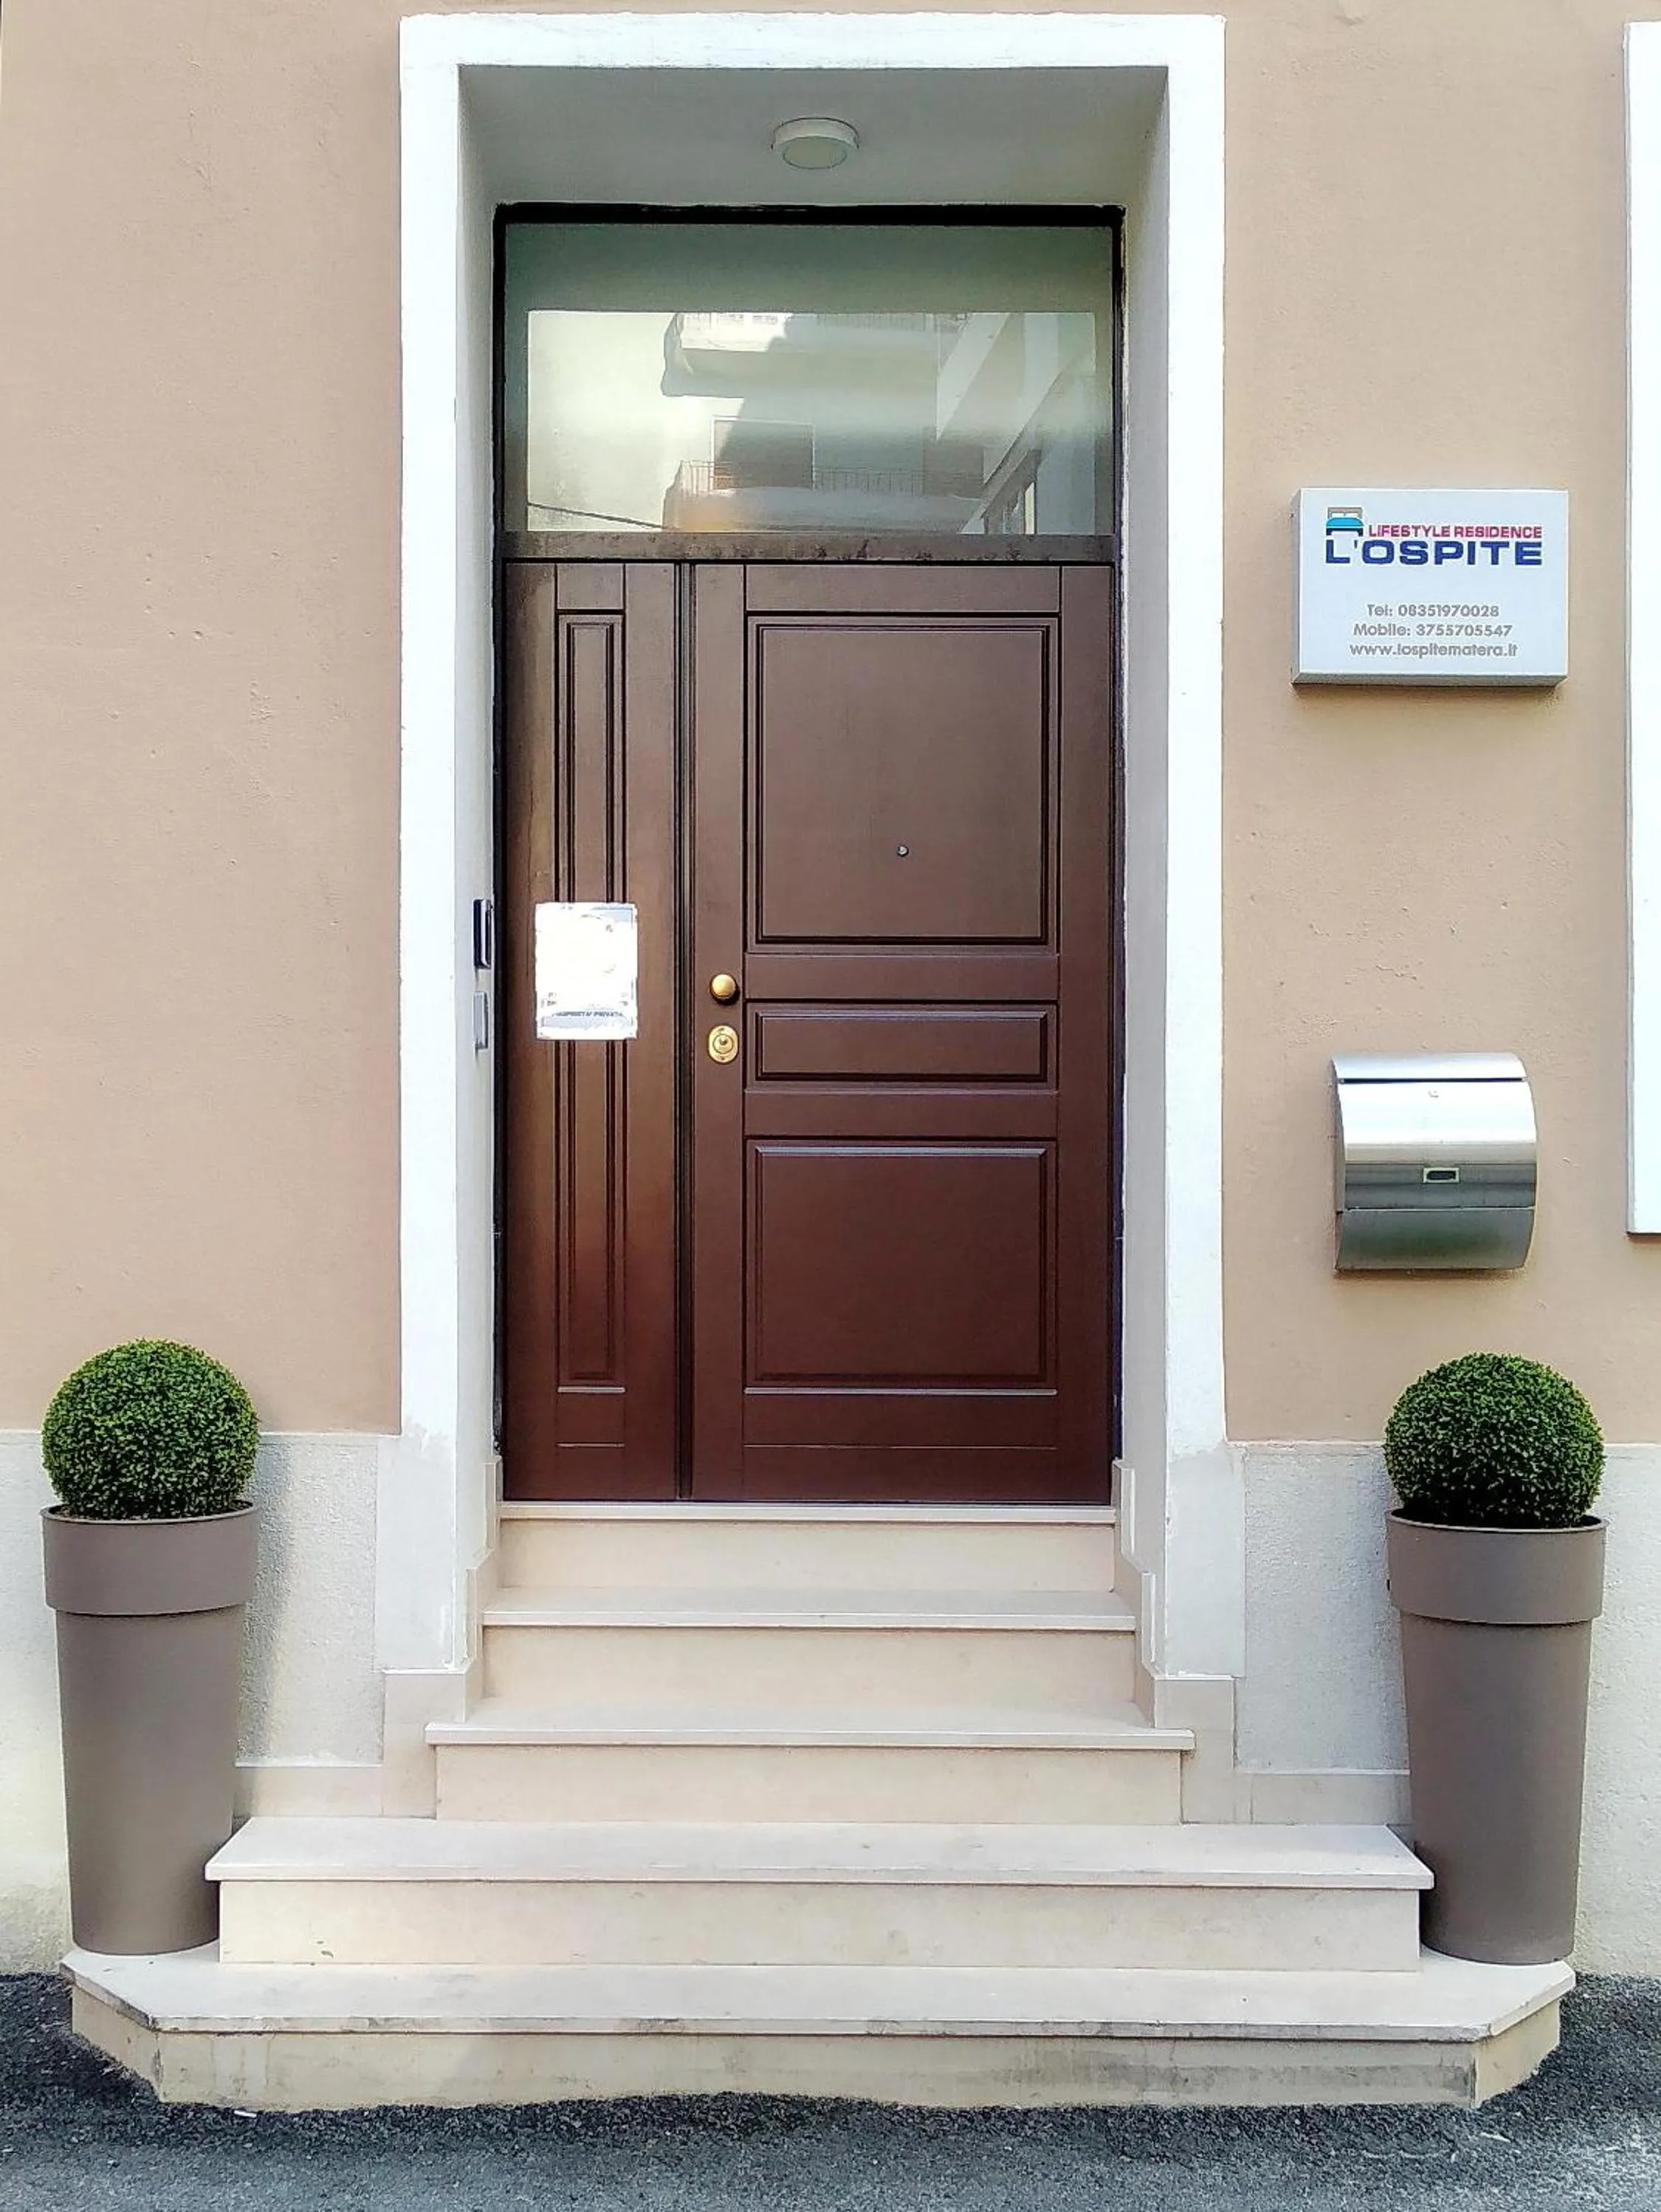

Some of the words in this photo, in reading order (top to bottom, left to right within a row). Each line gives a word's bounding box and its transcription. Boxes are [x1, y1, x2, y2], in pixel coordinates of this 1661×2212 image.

[1368, 524, 1450, 538] LIFESTYLE
[1454, 526, 1542, 539] RESIDENCE
[1326, 540, 1542, 565] L'OSPITE
[1366, 604, 1393, 617] Tel:
[1397, 604, 1499, 617] 08351970028
[1353, 624, 1411, 636] Mobile:
[1416, 624, 1513, 637] 3755705547
[1349, 643, 1518, 659] www.lospitematera.it
